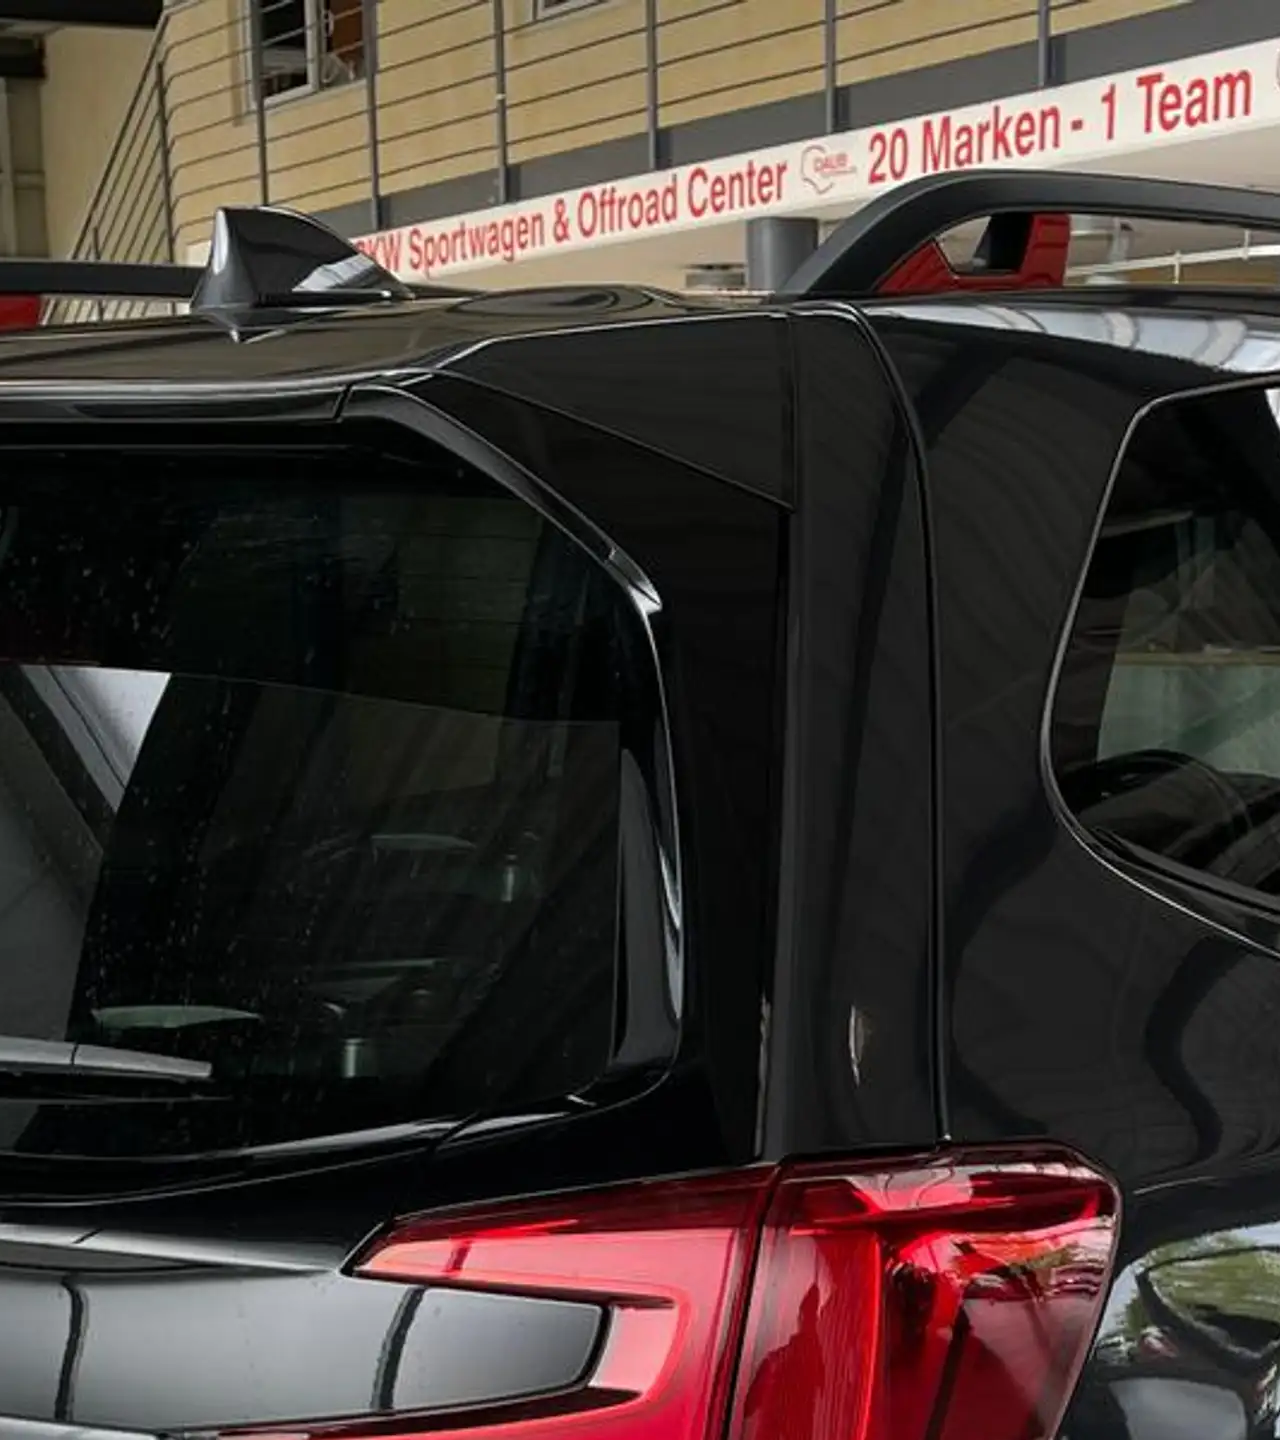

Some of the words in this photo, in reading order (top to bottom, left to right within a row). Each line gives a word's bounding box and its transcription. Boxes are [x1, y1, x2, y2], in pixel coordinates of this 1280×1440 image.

[868, 130, 908, 184] 20
[922, 104, 1061, 174] Marken
[1070, 118, 1083, 131] -
[1101, 83, 1116, 140] 1
[1136, 67, 1252, 134] Team
[409, 212, 545, 279] Sportwagen
[553, 198, 571, 243] &
[577, 175, 678, 237] Offroad
[688, 160, 787, 218] Center
